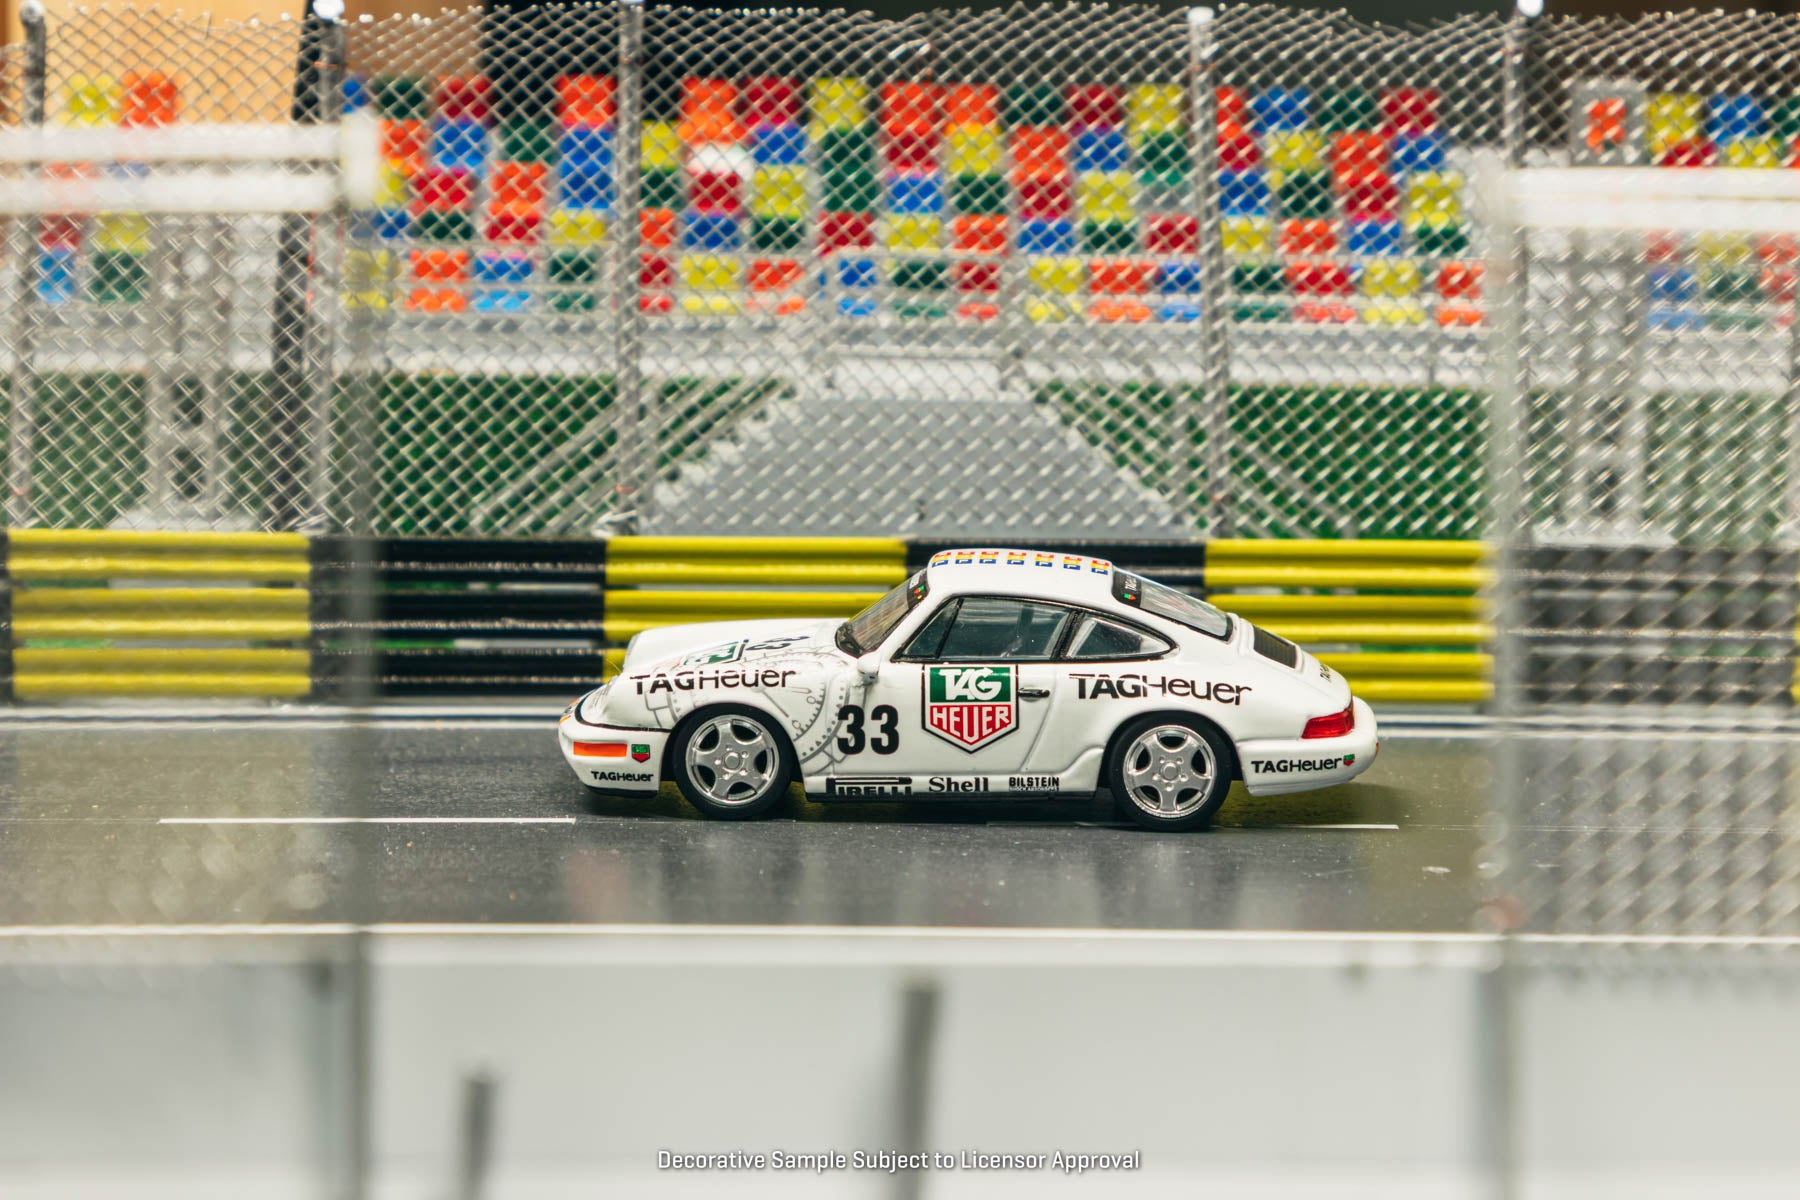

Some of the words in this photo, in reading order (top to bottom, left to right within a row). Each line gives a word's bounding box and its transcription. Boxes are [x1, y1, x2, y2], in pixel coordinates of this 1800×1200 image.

[938, 667, 1002, 700] TAG
[837, 704, 899, 755] 33
[932, 706, 1010, 743] HEUER
[928, 777, 989, 793] Shell
[1009, 777, 1060, 788] BILSTEIN
